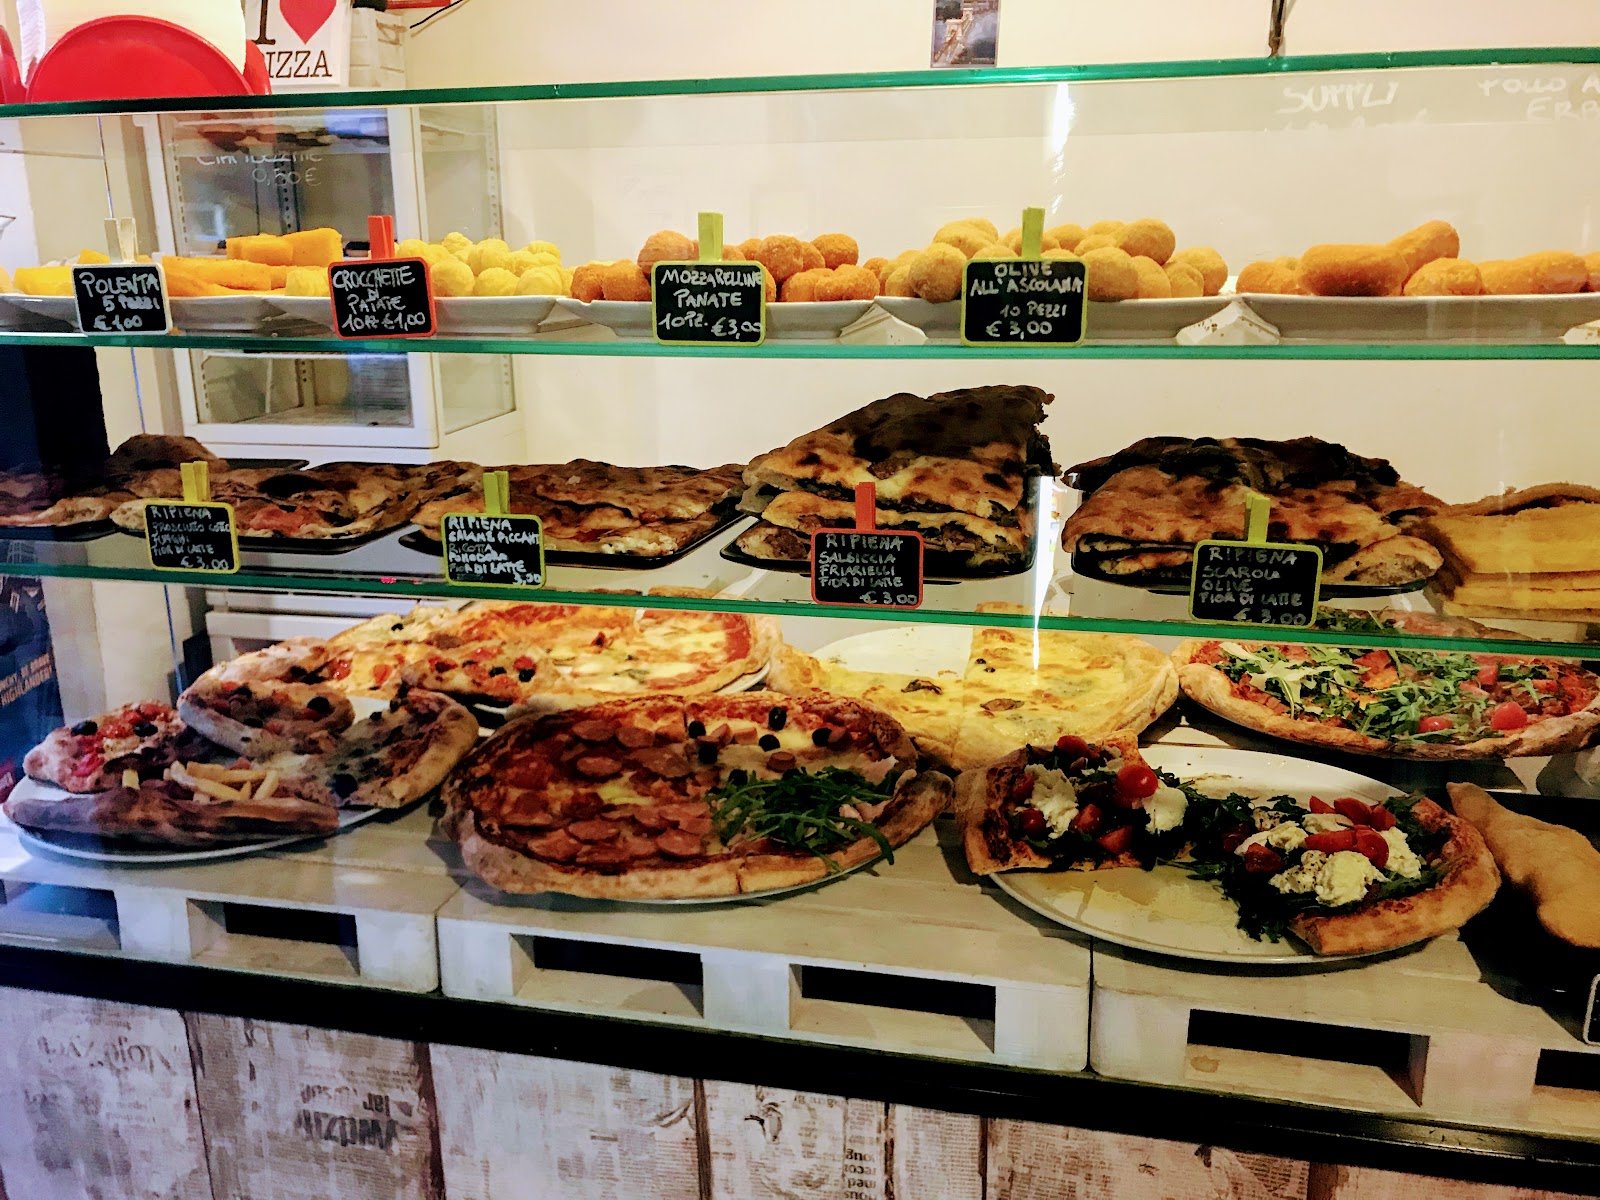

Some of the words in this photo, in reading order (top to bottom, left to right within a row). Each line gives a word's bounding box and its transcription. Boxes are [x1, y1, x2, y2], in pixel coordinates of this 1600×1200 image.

[332, 265, 416, 291] CROCCHETTE
[994, 261, 1053, 278] OLIVE
[79, 272, 160, 297] POLENTA
[102, 295, 115, 312] 5
[346, 293, 406, 315] PATATE
[673, 288, 742, 308] PANATE
[1000, 304, 1020, 318] 10
[150, 505, 212, 519] RIPIENA
[448, 516, 512, 531] RIPIENA
[826, 533, 904, 552] RIPIENA
[818, 551, 896, 564] SALSICCIA
[1209, 546, 1298, 566] RIPIENA
[1202, 565, 1280, 580] SCAROLA
[1201, 578, 1253, 592] OLIVE
